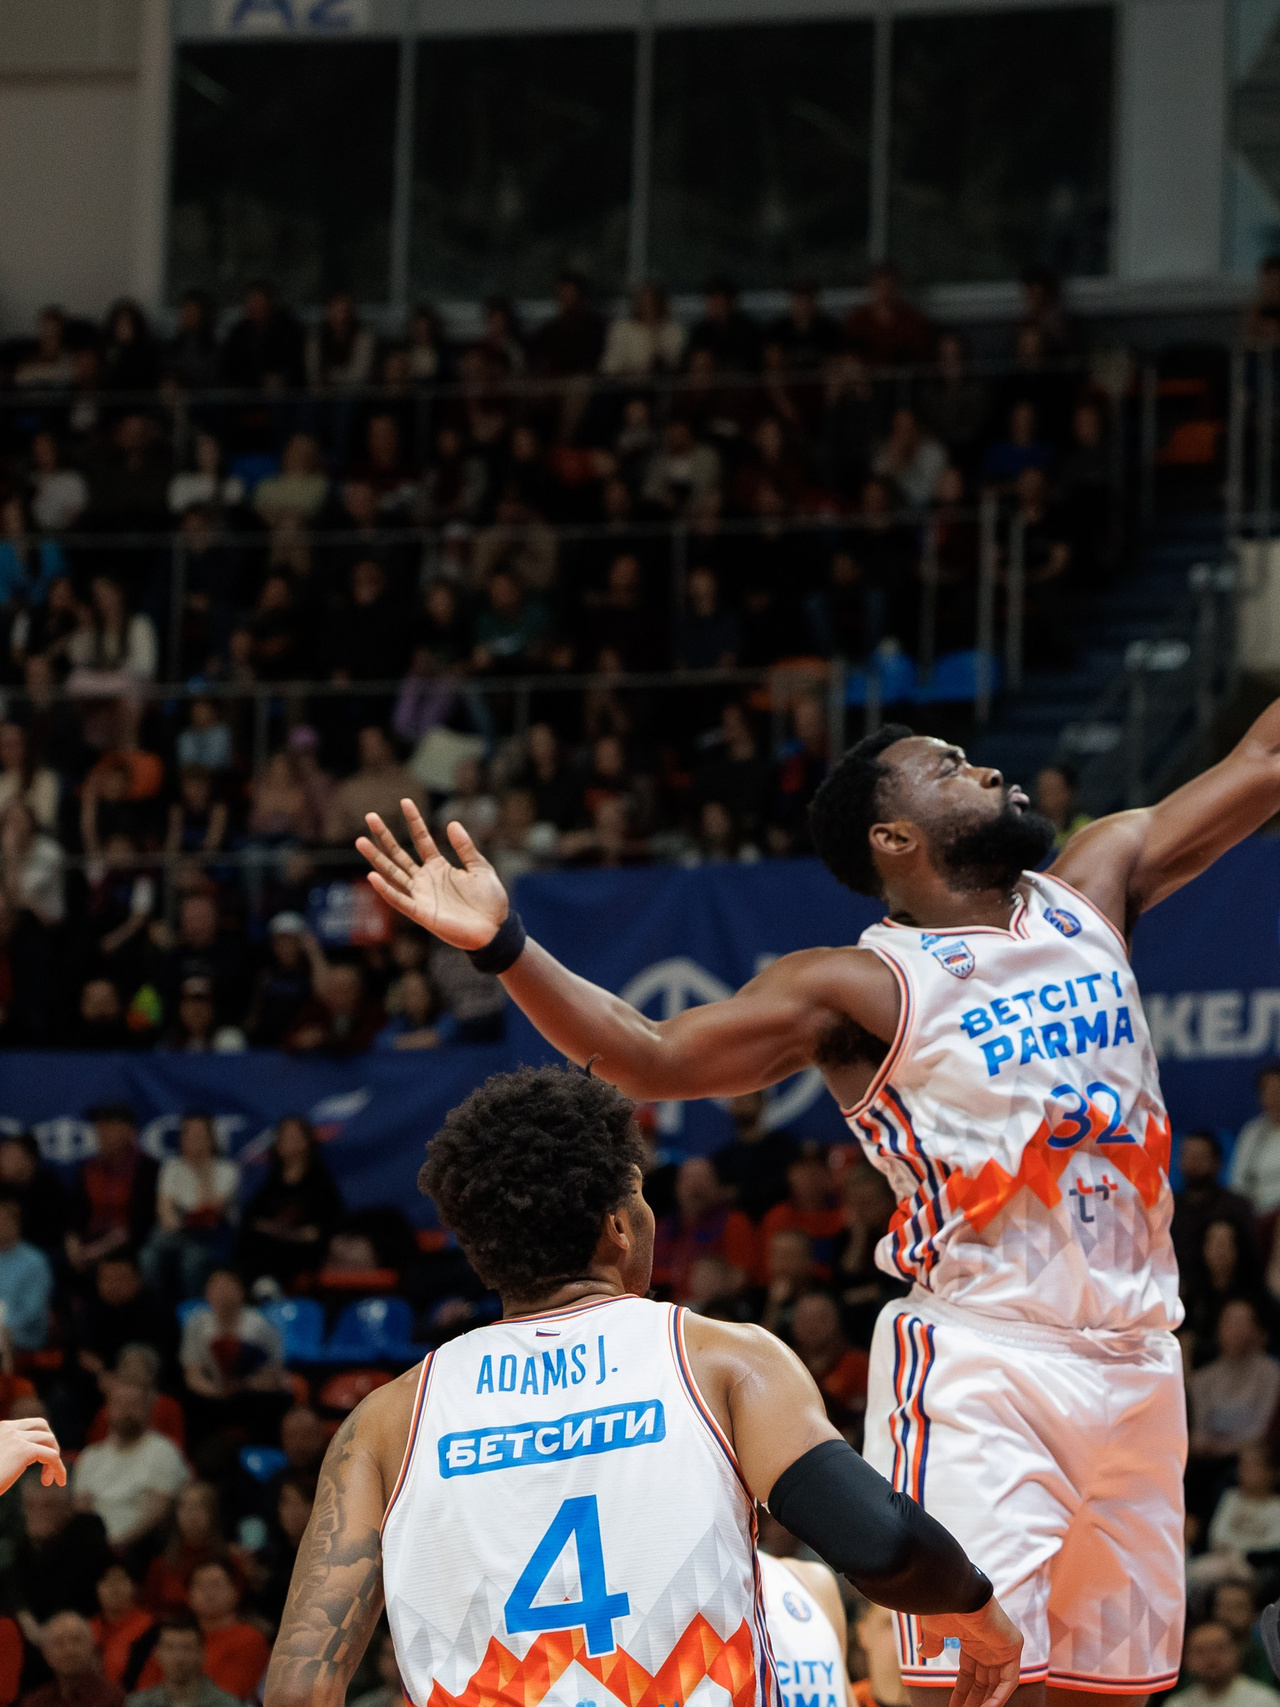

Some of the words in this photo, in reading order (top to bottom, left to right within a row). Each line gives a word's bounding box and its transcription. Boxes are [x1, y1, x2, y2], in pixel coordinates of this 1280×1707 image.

[960, 971, 1122, 1040] BETCITY
[979, 1006, 1135, 1077] PARMA
[1047, 1081, 1137, 1148] 32
[476, 1343, 587, 1395] ADAMS
[596, 1335, 619, 1386] J.
[446, 1407, 656, 1469] БЕТСИТИ
[503, 1494, 631, 1657] 4
[776, 1660, 834, 1686] CITY
